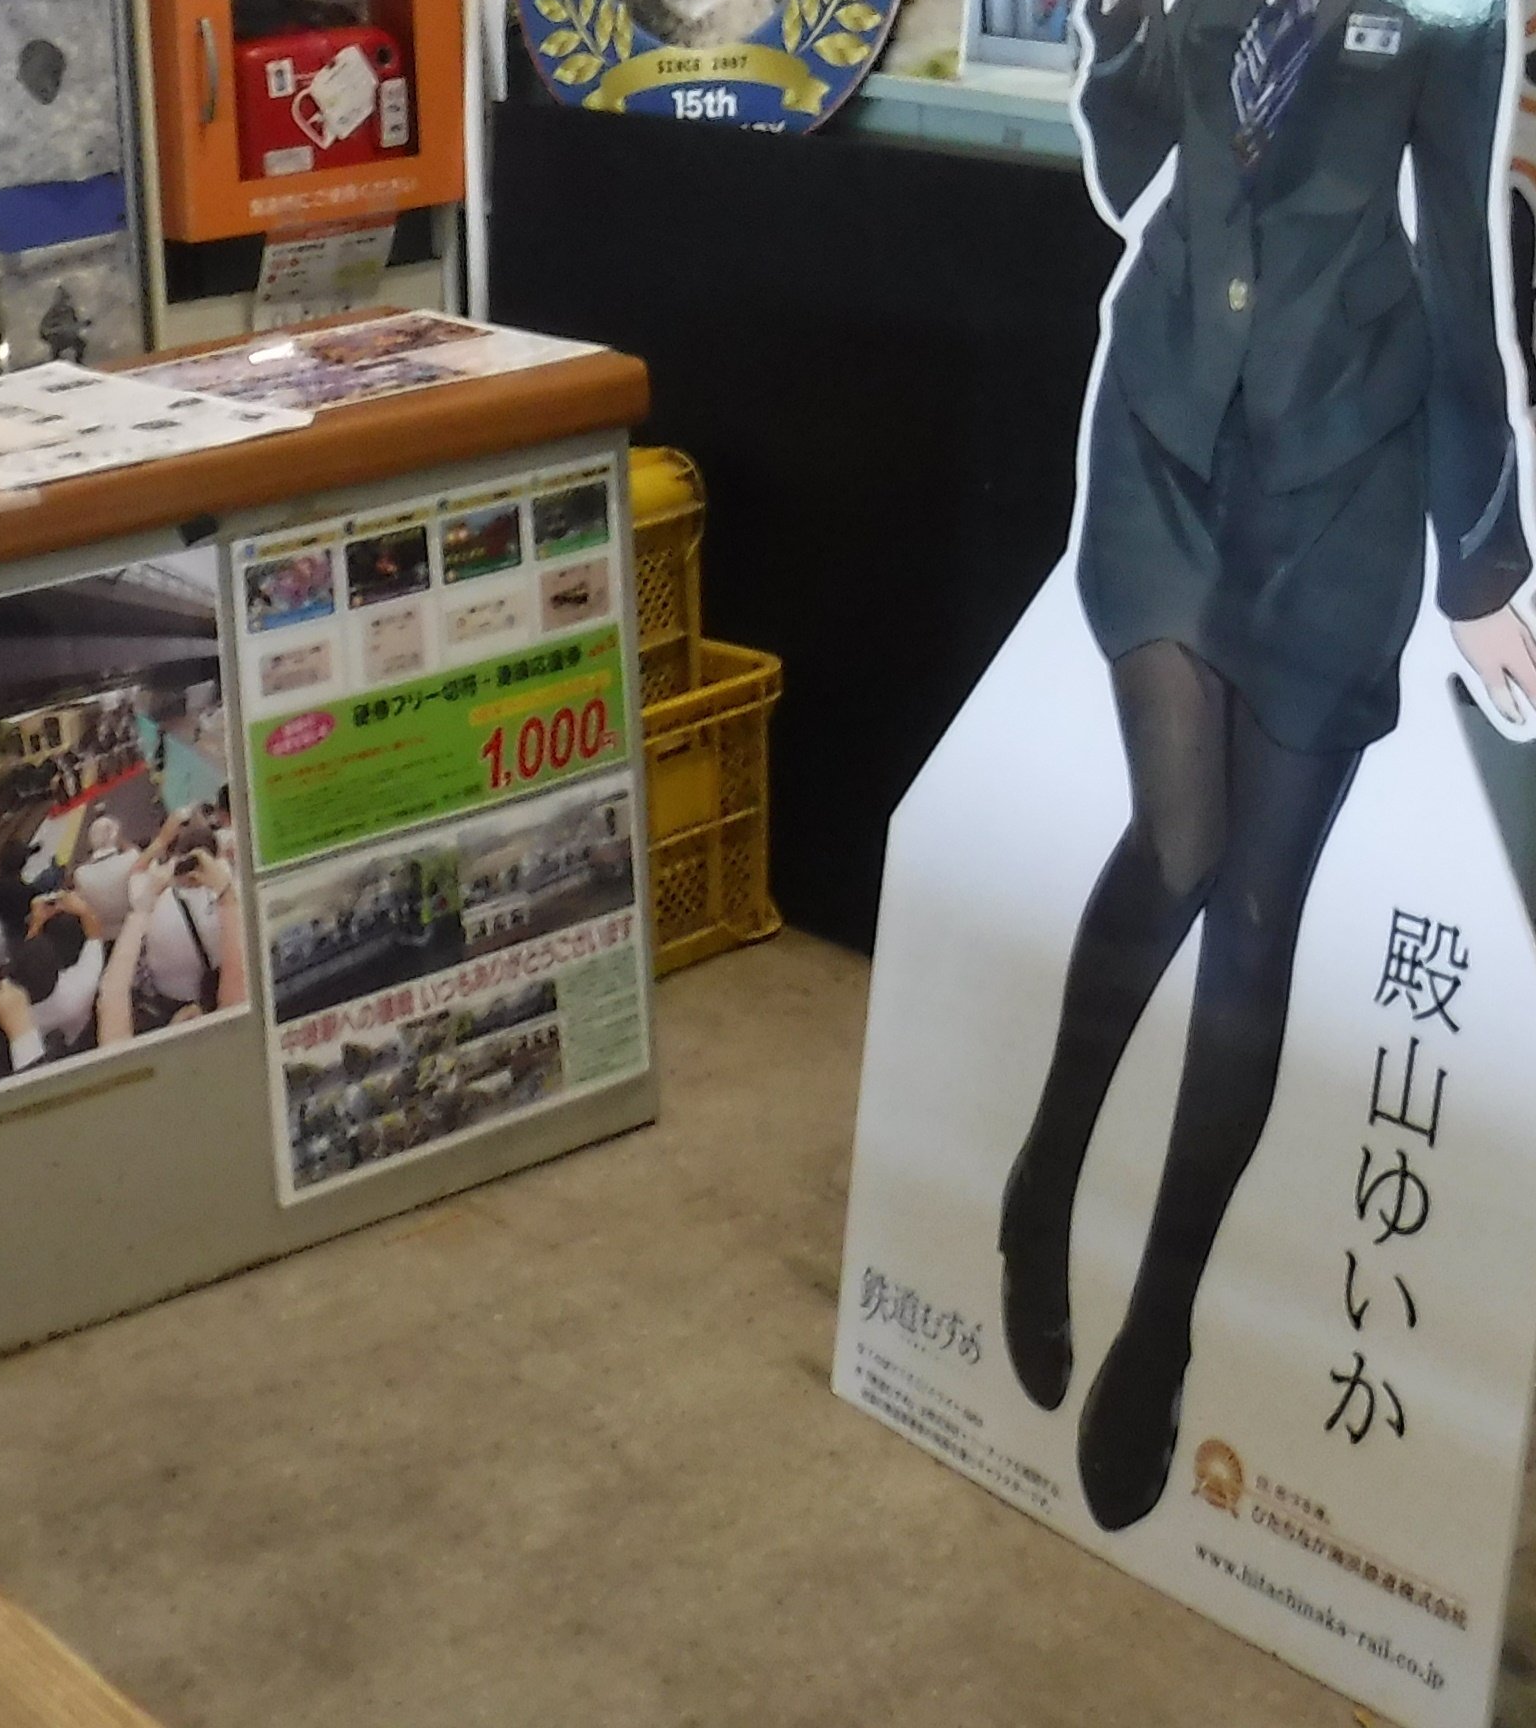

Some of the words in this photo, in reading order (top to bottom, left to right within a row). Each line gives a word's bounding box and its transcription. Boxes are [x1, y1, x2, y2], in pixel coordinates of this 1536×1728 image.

[671, 86, 738, 120] 15th
[1325, 908, 1469, 1445] 殿山ゆいか
